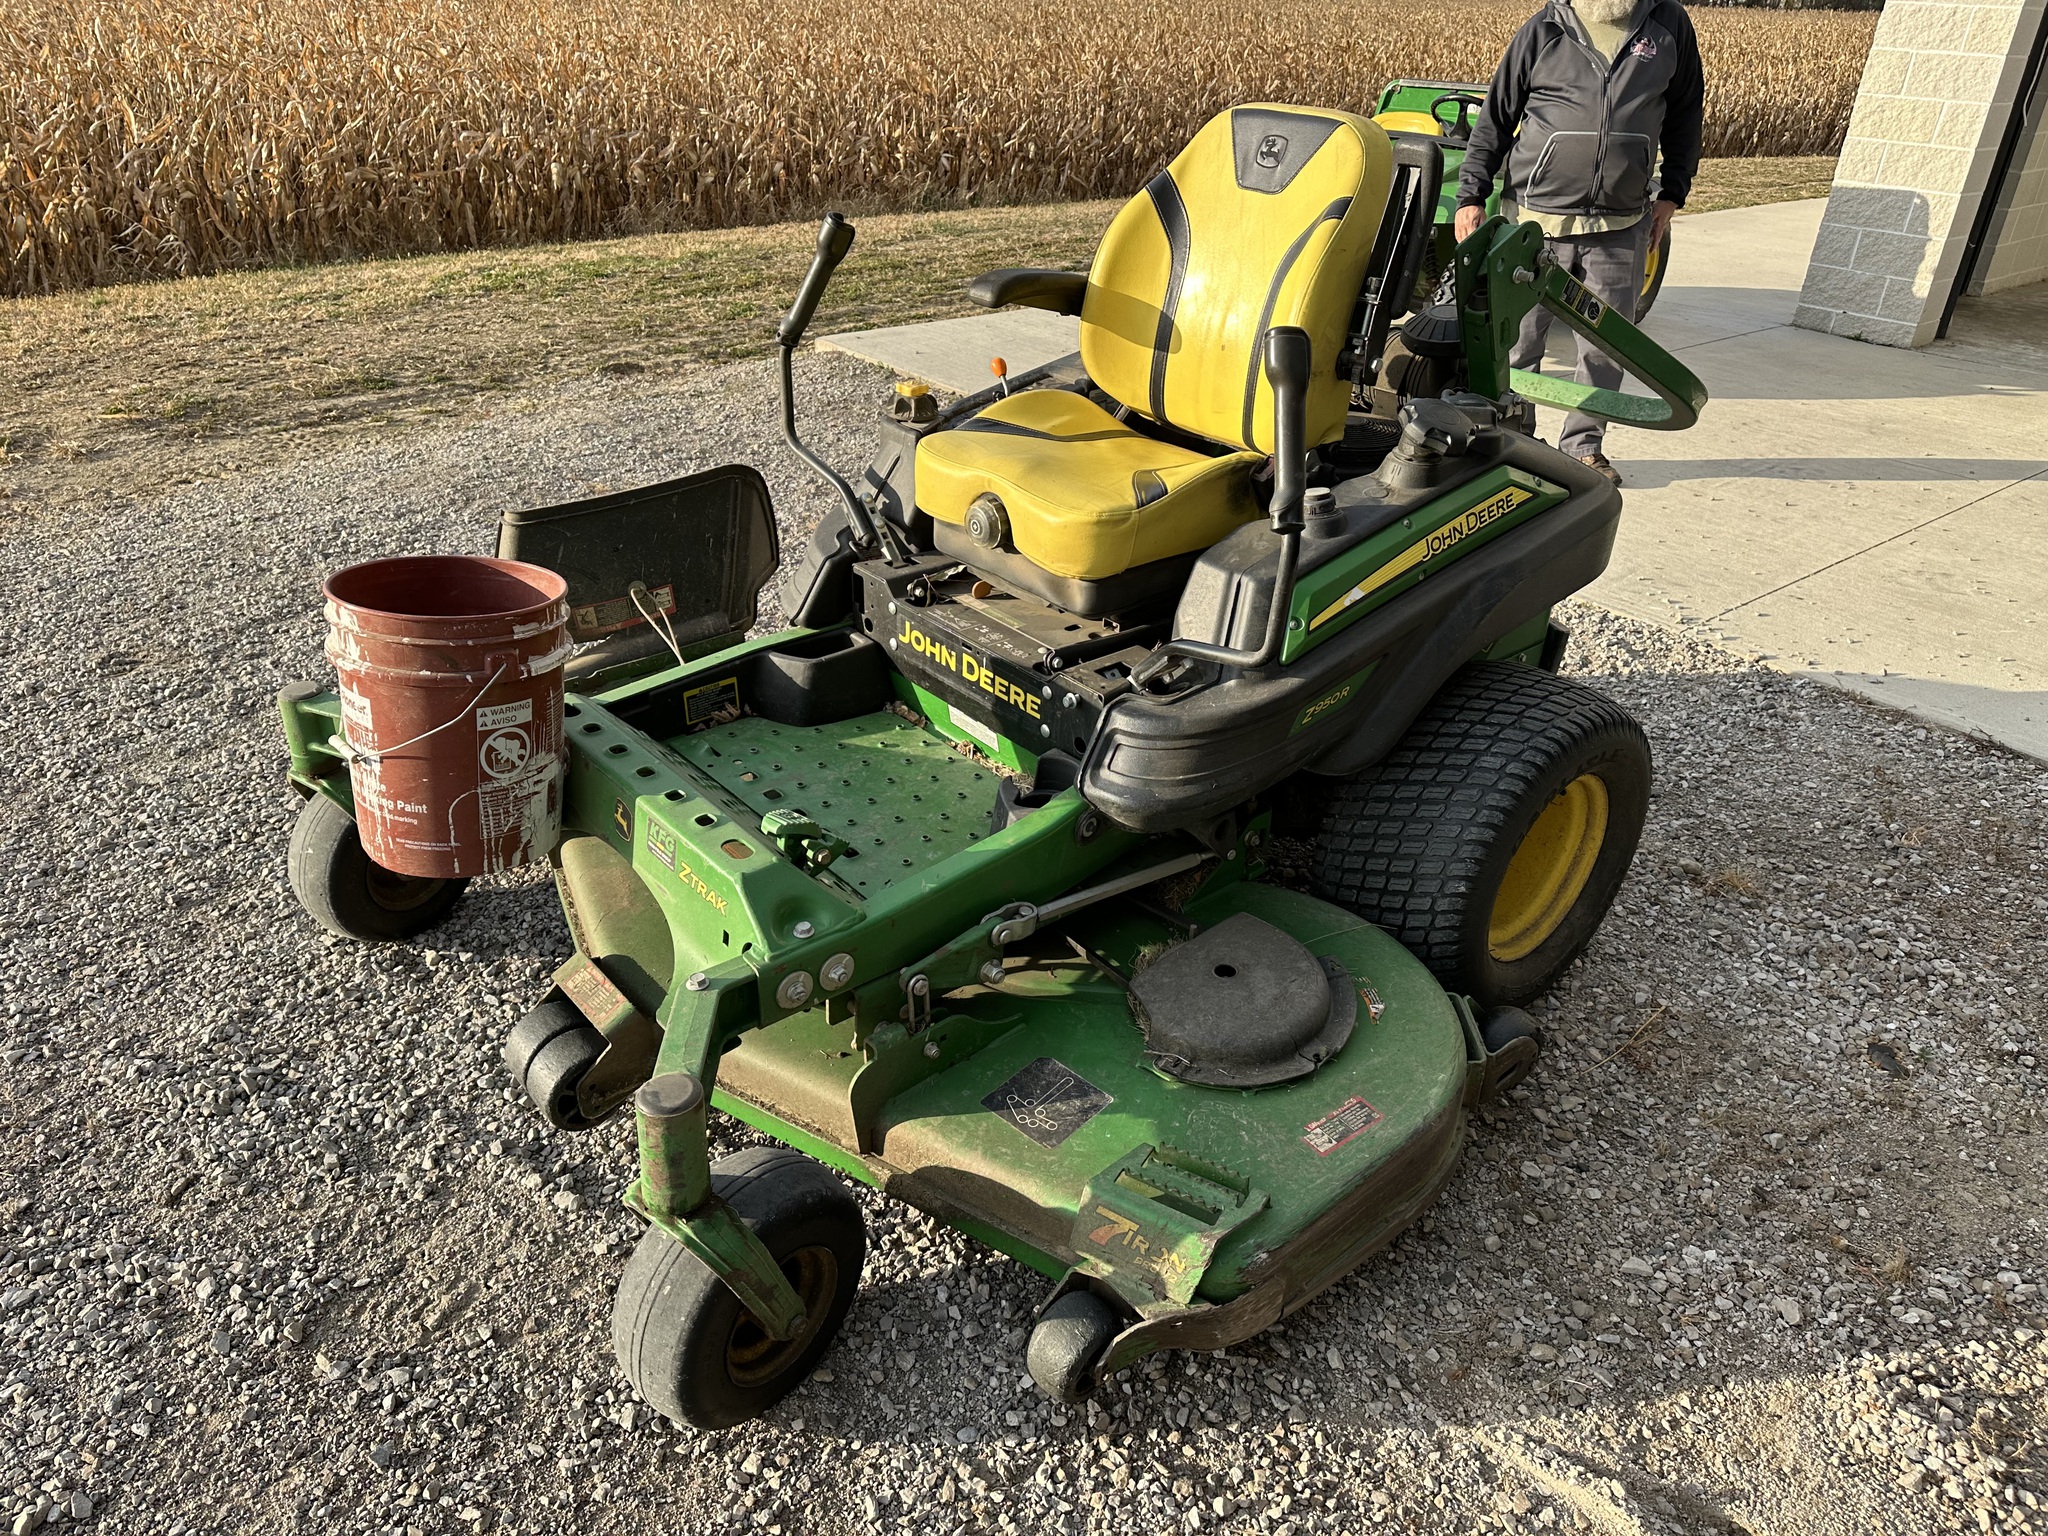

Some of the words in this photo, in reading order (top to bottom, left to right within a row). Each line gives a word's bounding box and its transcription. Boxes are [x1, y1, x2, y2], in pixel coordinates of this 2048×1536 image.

[1422, 522, 1465, 561] JOHN
[1467, 492, 1516, 531] DEERE
[899, 621, 957, 672] JOHN
[962, 653, 1041, 720] DEERE
[490, 701, 531, 717] WARNING
[490, 715, 517, 726] AVISO
[1302, 685, 1350, 725] Z950R
[396, 800, 428, 814] Paint
[649, 822, 675, 852] KFG
[678, 862, 728, 917] ZTRAK
